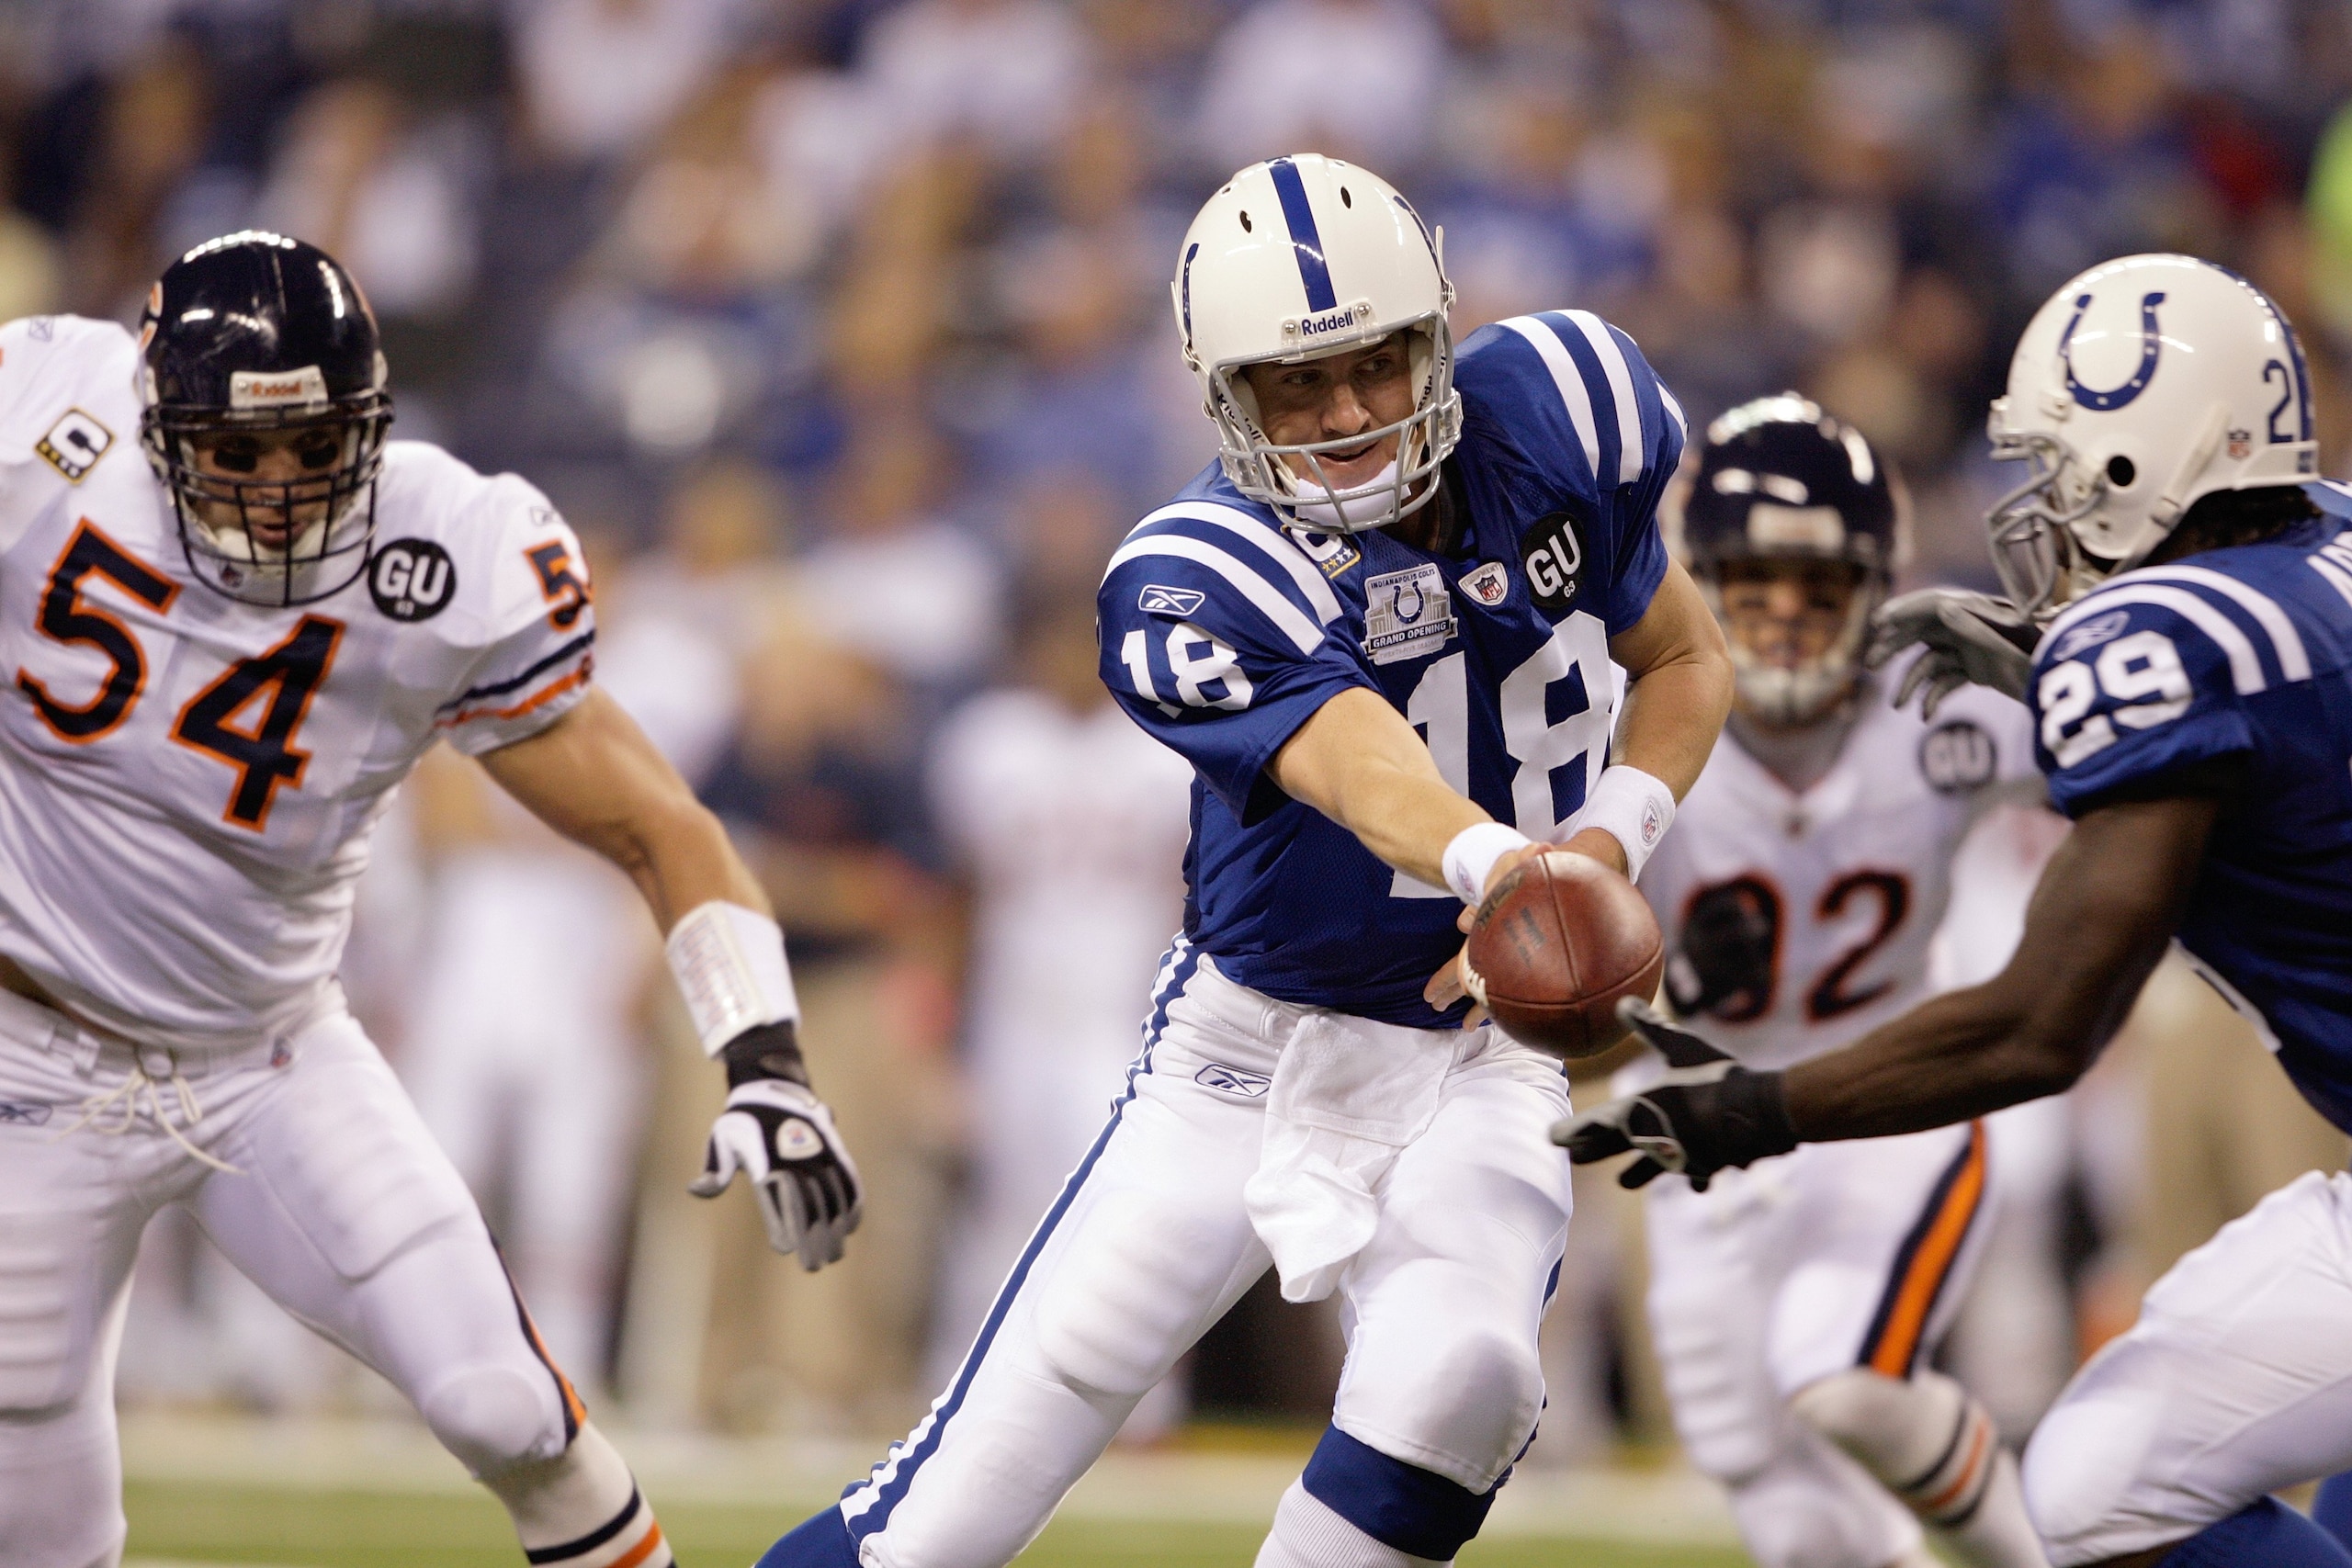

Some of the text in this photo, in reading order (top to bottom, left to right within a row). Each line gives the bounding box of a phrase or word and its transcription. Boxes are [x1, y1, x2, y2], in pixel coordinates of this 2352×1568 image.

[1301, 310, 1353, 336] Riddell
[376, 548, 449, 605] GU
[522, 536, 594, 632] 5
[1371, 569, 1435, 589] INDIANAPOLIS COLTS
[1525, 520, 1581, 597] GU
[1563, 580, 1576, 598] 63
[15, 515, 346, 832] 54
[1121, 621, 1254, 719] 18
[1373, 622, 1447, 649] GRAND OPENING
[2038, 630, 2193, 770] 29
[1389, 609, 1614, 898] 18
